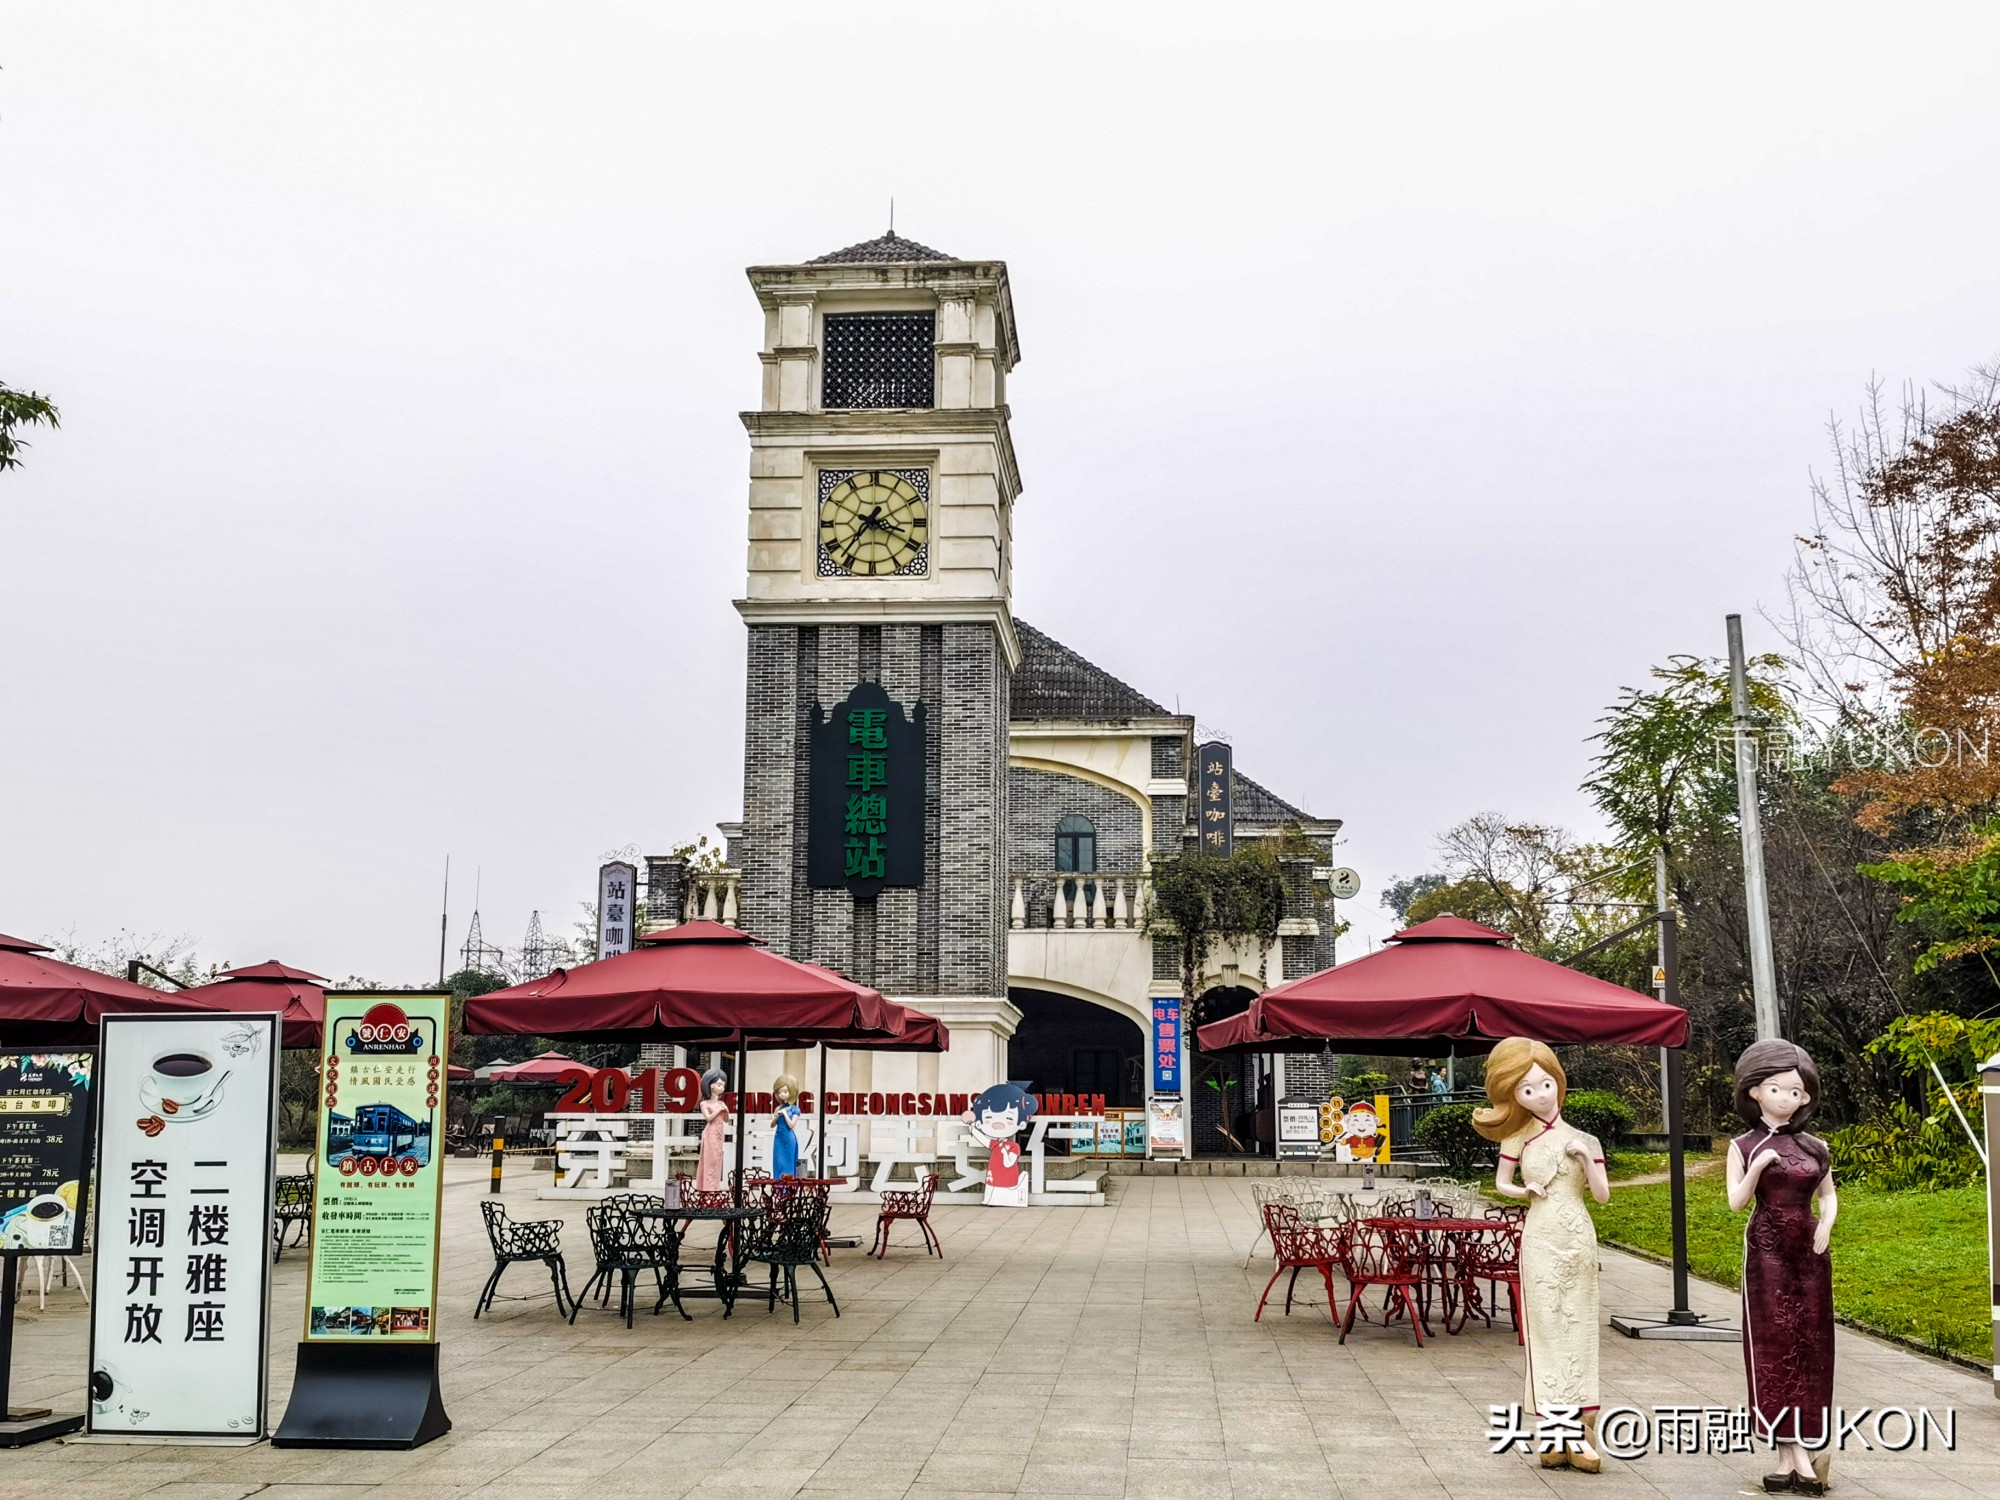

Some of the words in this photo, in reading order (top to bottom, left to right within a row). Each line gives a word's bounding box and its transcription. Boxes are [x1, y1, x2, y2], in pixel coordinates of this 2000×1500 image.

[844, 708, 889, 878] 電車總站
[1153, 1008, 1180, 1021] 电车
[362, 1043, 406, 1051] ANRENHAO
[1157, 1023, 1177, 1068] 售票处
[555, 1067, 701, 1114] 2019
[45, 1135, 64, 1143] 38元
[42, 1168, 60, 1177] 78元
[123, 1159, 168, 1345] 空调开放
[185, 1160, 230, 1343] 二楼雅座
